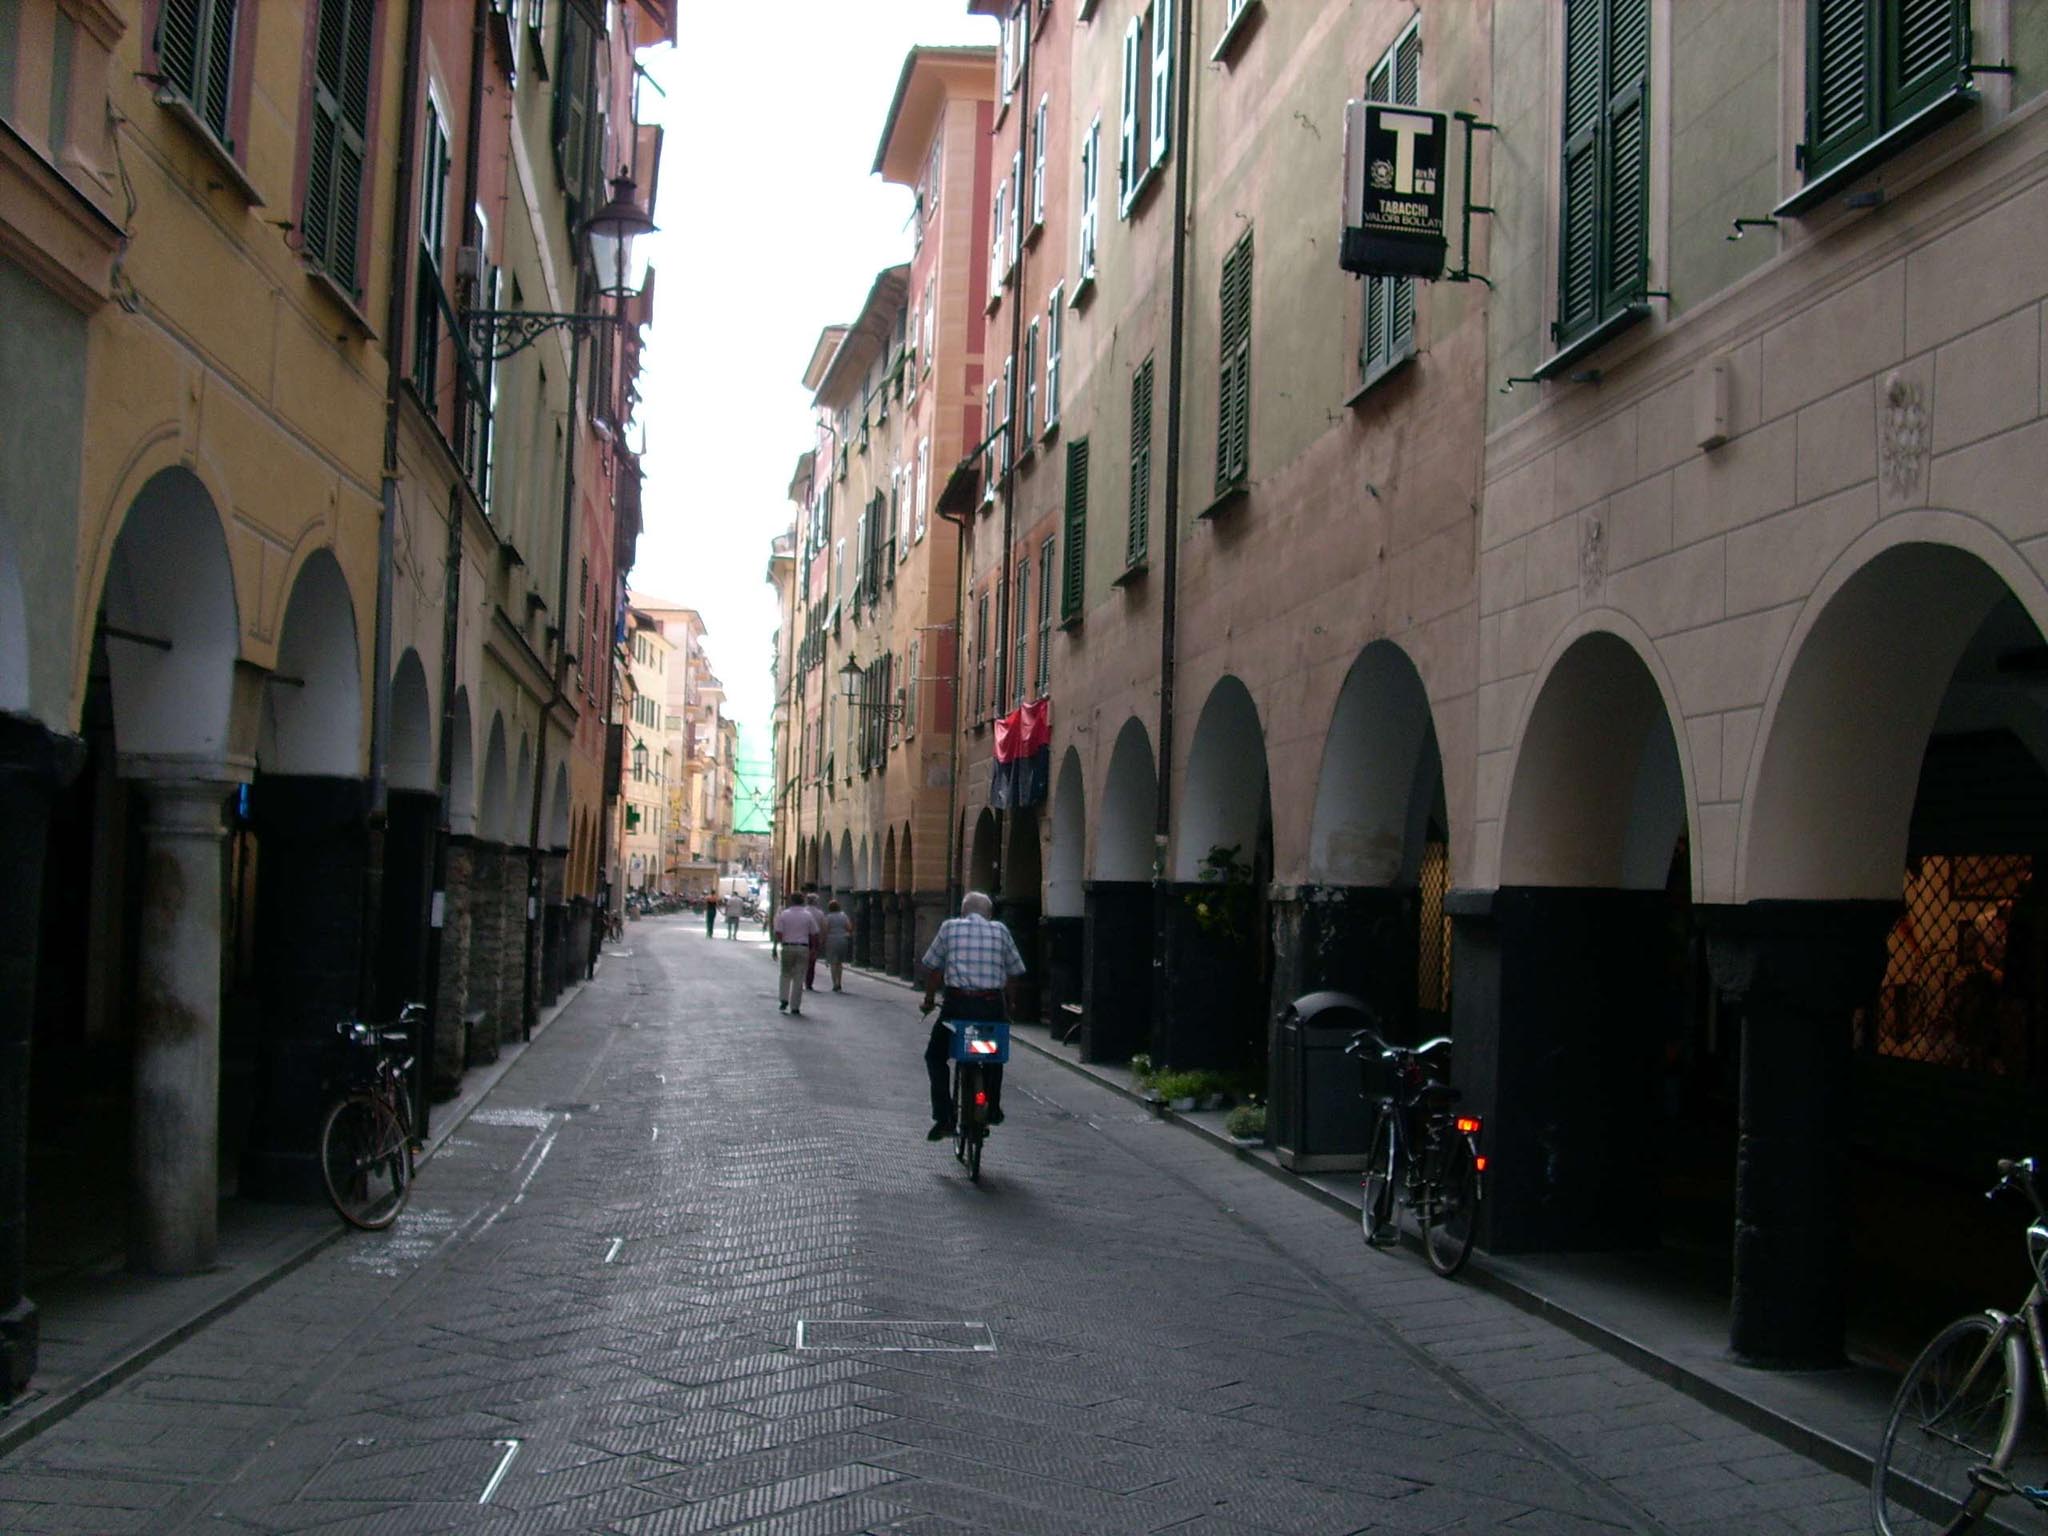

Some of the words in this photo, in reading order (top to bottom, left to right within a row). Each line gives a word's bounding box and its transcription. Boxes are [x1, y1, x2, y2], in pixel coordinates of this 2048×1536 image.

[1380, 112, 1433, 194] T
[1379, 200, 1428, 217] TABACCHI
[1365, 213, 1400, 224] VALORI
[1402, 216, 1442, 228] BOLLATI
